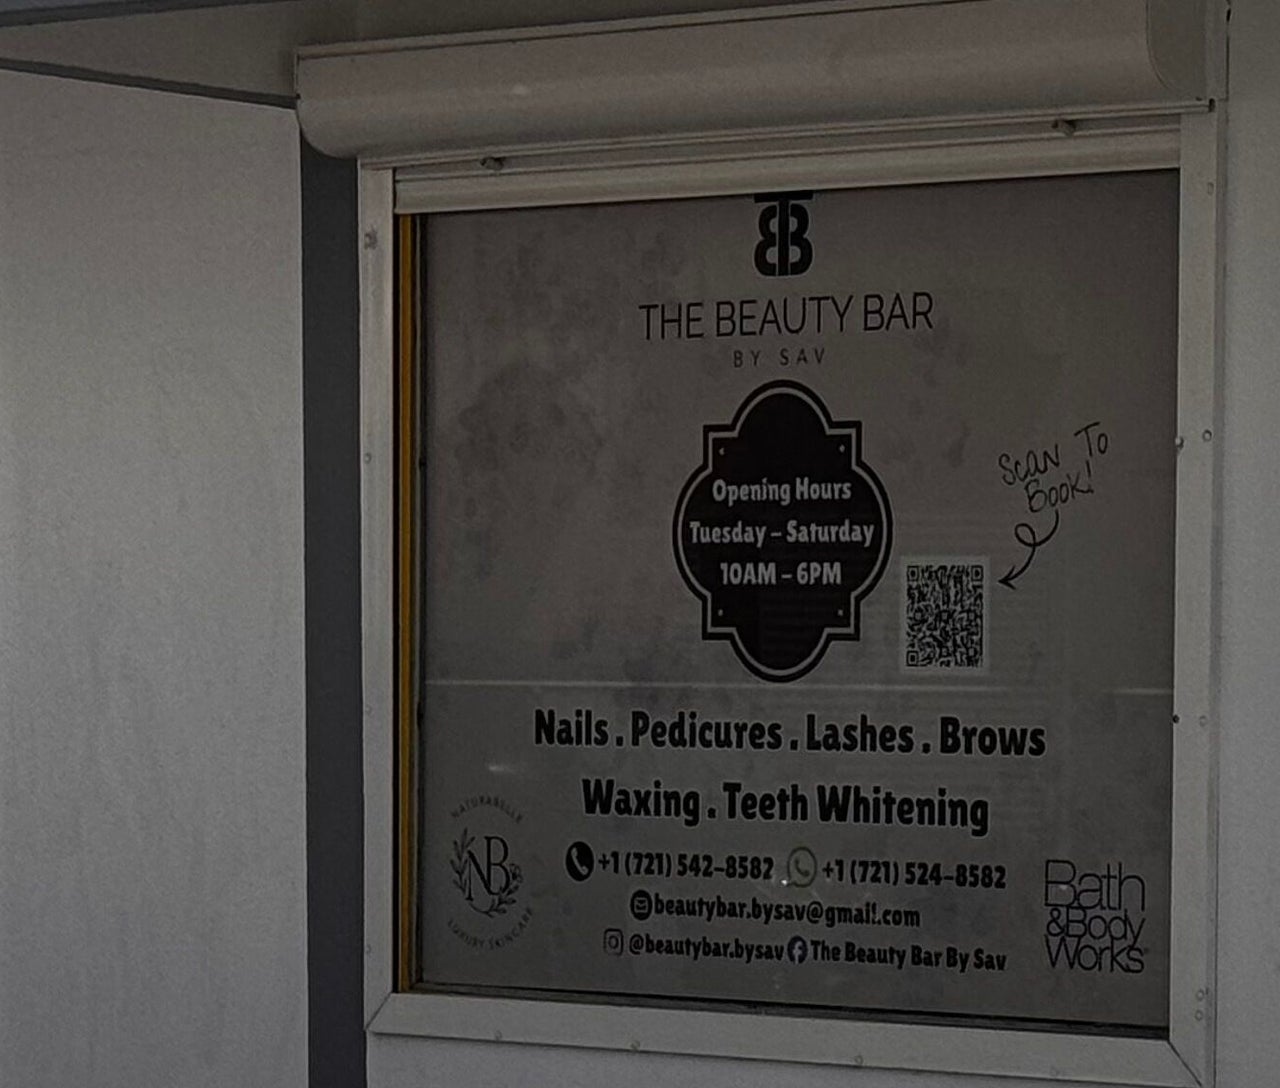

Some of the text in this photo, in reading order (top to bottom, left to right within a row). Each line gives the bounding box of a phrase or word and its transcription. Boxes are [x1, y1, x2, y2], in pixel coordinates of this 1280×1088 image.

[639, 291, 934, 341] THE BEAUTY BAR
[733, 347, 826, 368] BY SAV
[713, 477, 852, 506] Opening Hours
[689, 520, 767, 548] Tuesday
[787, 520, 875, 548] Saturday
[721, 561, 777, 586] 10AM
[797, 561, 842, 586] 6PM
[535, 709, 610, 747] Nails
[631, 710, 783, 752] Pedicures
[807, 714, 914, 754] Lashes
[939, 717, 1046, 757] Brows
[582, 779, 701, 826] Waxing
[724, 782, 808, 822] Teeth
[817, 785, 990, 836] Whitening
[598, 851, 774, 880] +1 (721) 542-8582
[822, 859, 1006, 889] +1 (721) 524-8582
[1044, 859, 1145, 912] Bath
[629, 933, 784, 963] @beautybar.bysav
[811, 940, 1007, 973] The Beauty Bar By Sav
[1044, 934, 1145, 974] Works
